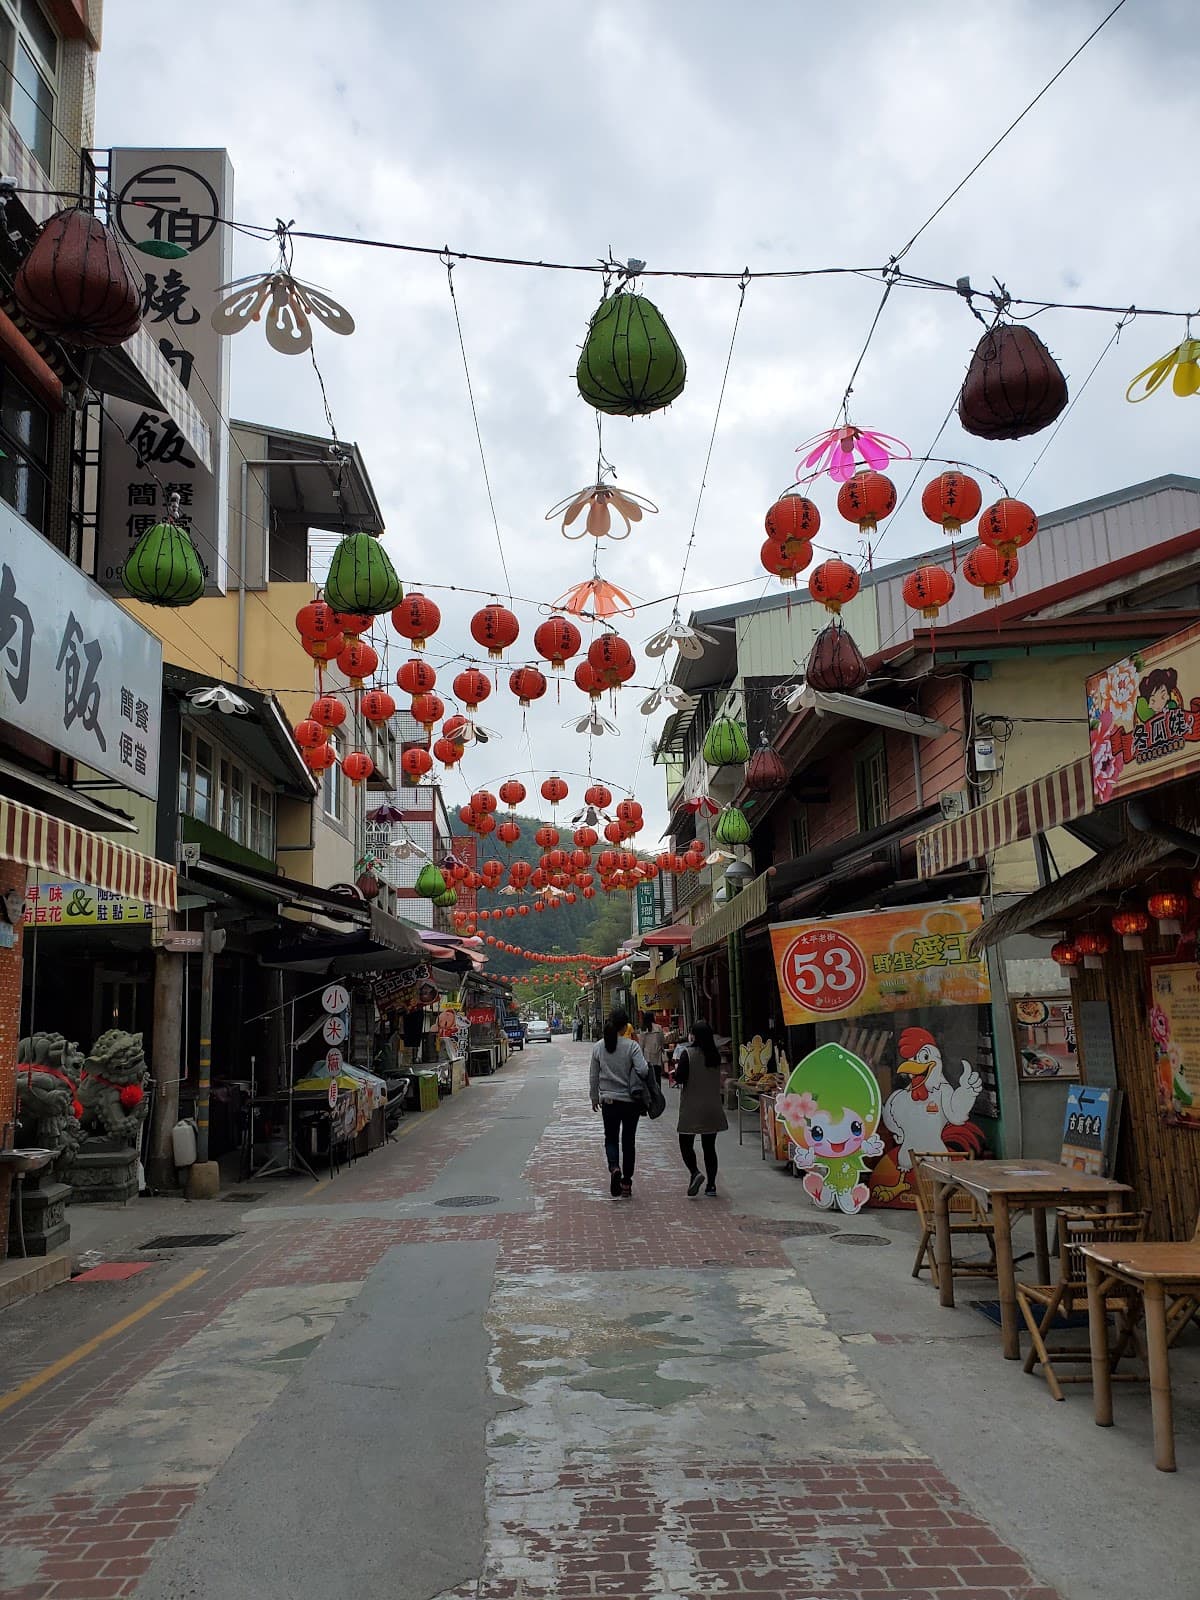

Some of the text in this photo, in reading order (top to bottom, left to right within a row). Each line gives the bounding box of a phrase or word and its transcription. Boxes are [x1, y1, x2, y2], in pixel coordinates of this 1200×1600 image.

[121, 685, 149, 734] 簡餐
[119, 731, 147, 776] 便當
[97, 902, 153, 920] 駐點二店
[801, 933, 836, 946] 太平老街
[793, 948, 856, 995] 53
